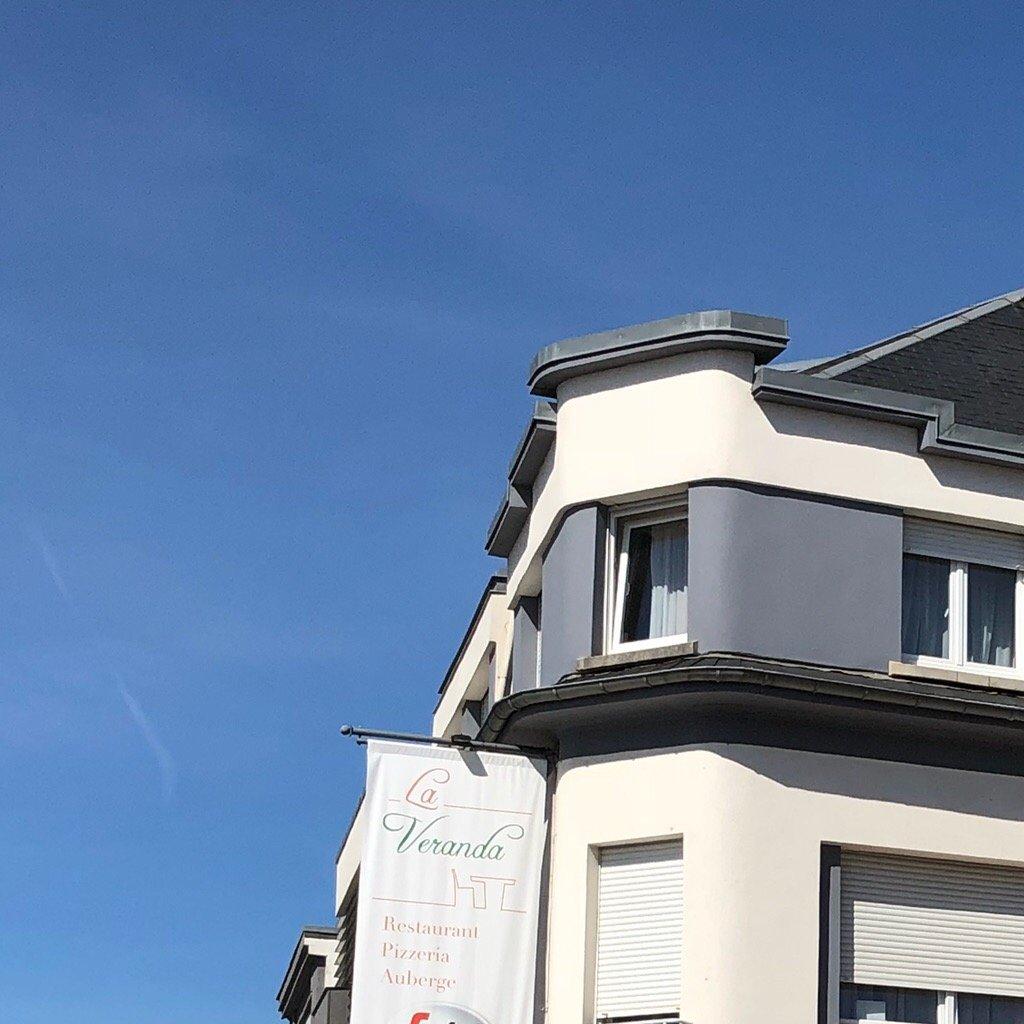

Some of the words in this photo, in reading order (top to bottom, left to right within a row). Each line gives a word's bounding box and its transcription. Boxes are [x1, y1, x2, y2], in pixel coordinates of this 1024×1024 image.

[406, 768, 450, 810] La
[382, 813, 525, 861] Veranda
[382, 916, 480, 939] Restaurant
[382, 942, 450, 964] Pizzeria
[380, 968, 457, 992] Auberge
